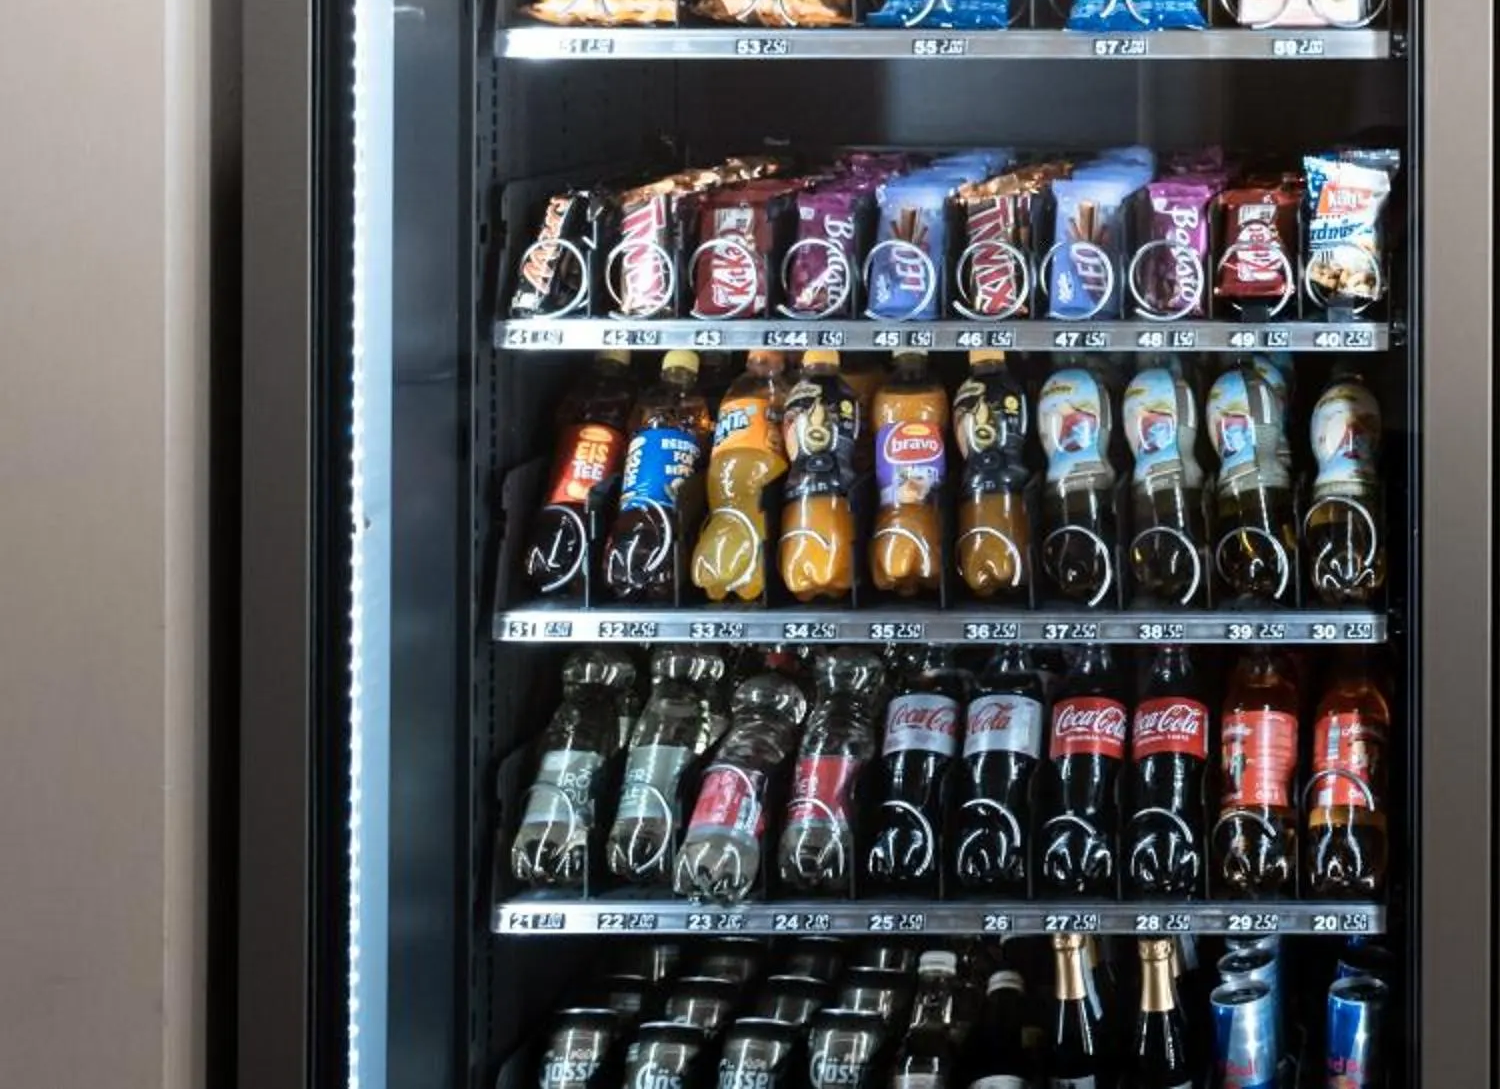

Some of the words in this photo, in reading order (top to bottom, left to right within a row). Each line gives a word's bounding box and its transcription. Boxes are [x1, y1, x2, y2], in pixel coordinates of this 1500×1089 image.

[737, 39, 762, 55] 53
[913, 39, 937, 55] 55
[1095, 39, 1118, 55] 57
[967, 195, 1016, 313] TWIX
[696, 331, 720, 346] 43
[783, 331, 807, 346] 44
[875, 331, 899, 346] 45
[958, 331, 982, 347] 46
[1055, 331, 1079, 347] 47
[1138, 331, 1162, 347] 48
[1231, 331, 1254, 347] 49
[1314, 331, 1339, 347] 40
[891, 434, 938, 452] bravo
[576, 441, 608, 463] EIS
[571, 460, 605, 480] TEE
[600, 623, 625, 637] 32
[692, 623, 717, 637] 33
[785, 624, 809, 639] 34
[871, 624, 895, 639] 35
[966, 624, 990, 639] 36
[1045, 624, 1069, 639] 37
[1140, 624, 1163, 639] 38
[1229, 624, 1252, 639] 39
[1313, 624, 1336, 639] 30
[511, 914, 533, 929] 21
[600, 914, 624, 929] 22
[689, 914, 712, 929] 23
[776, 915, 798, 930] 24
[870, 915, 893, 930] 25
[985, 915, 1008, 930] 26
[1046, 915, 1069, 930] 27
[1136, 915, 1159, 930] 28
[1228, 915, 1251, 930] 29
[1313, 915, 1336, 930] 20
